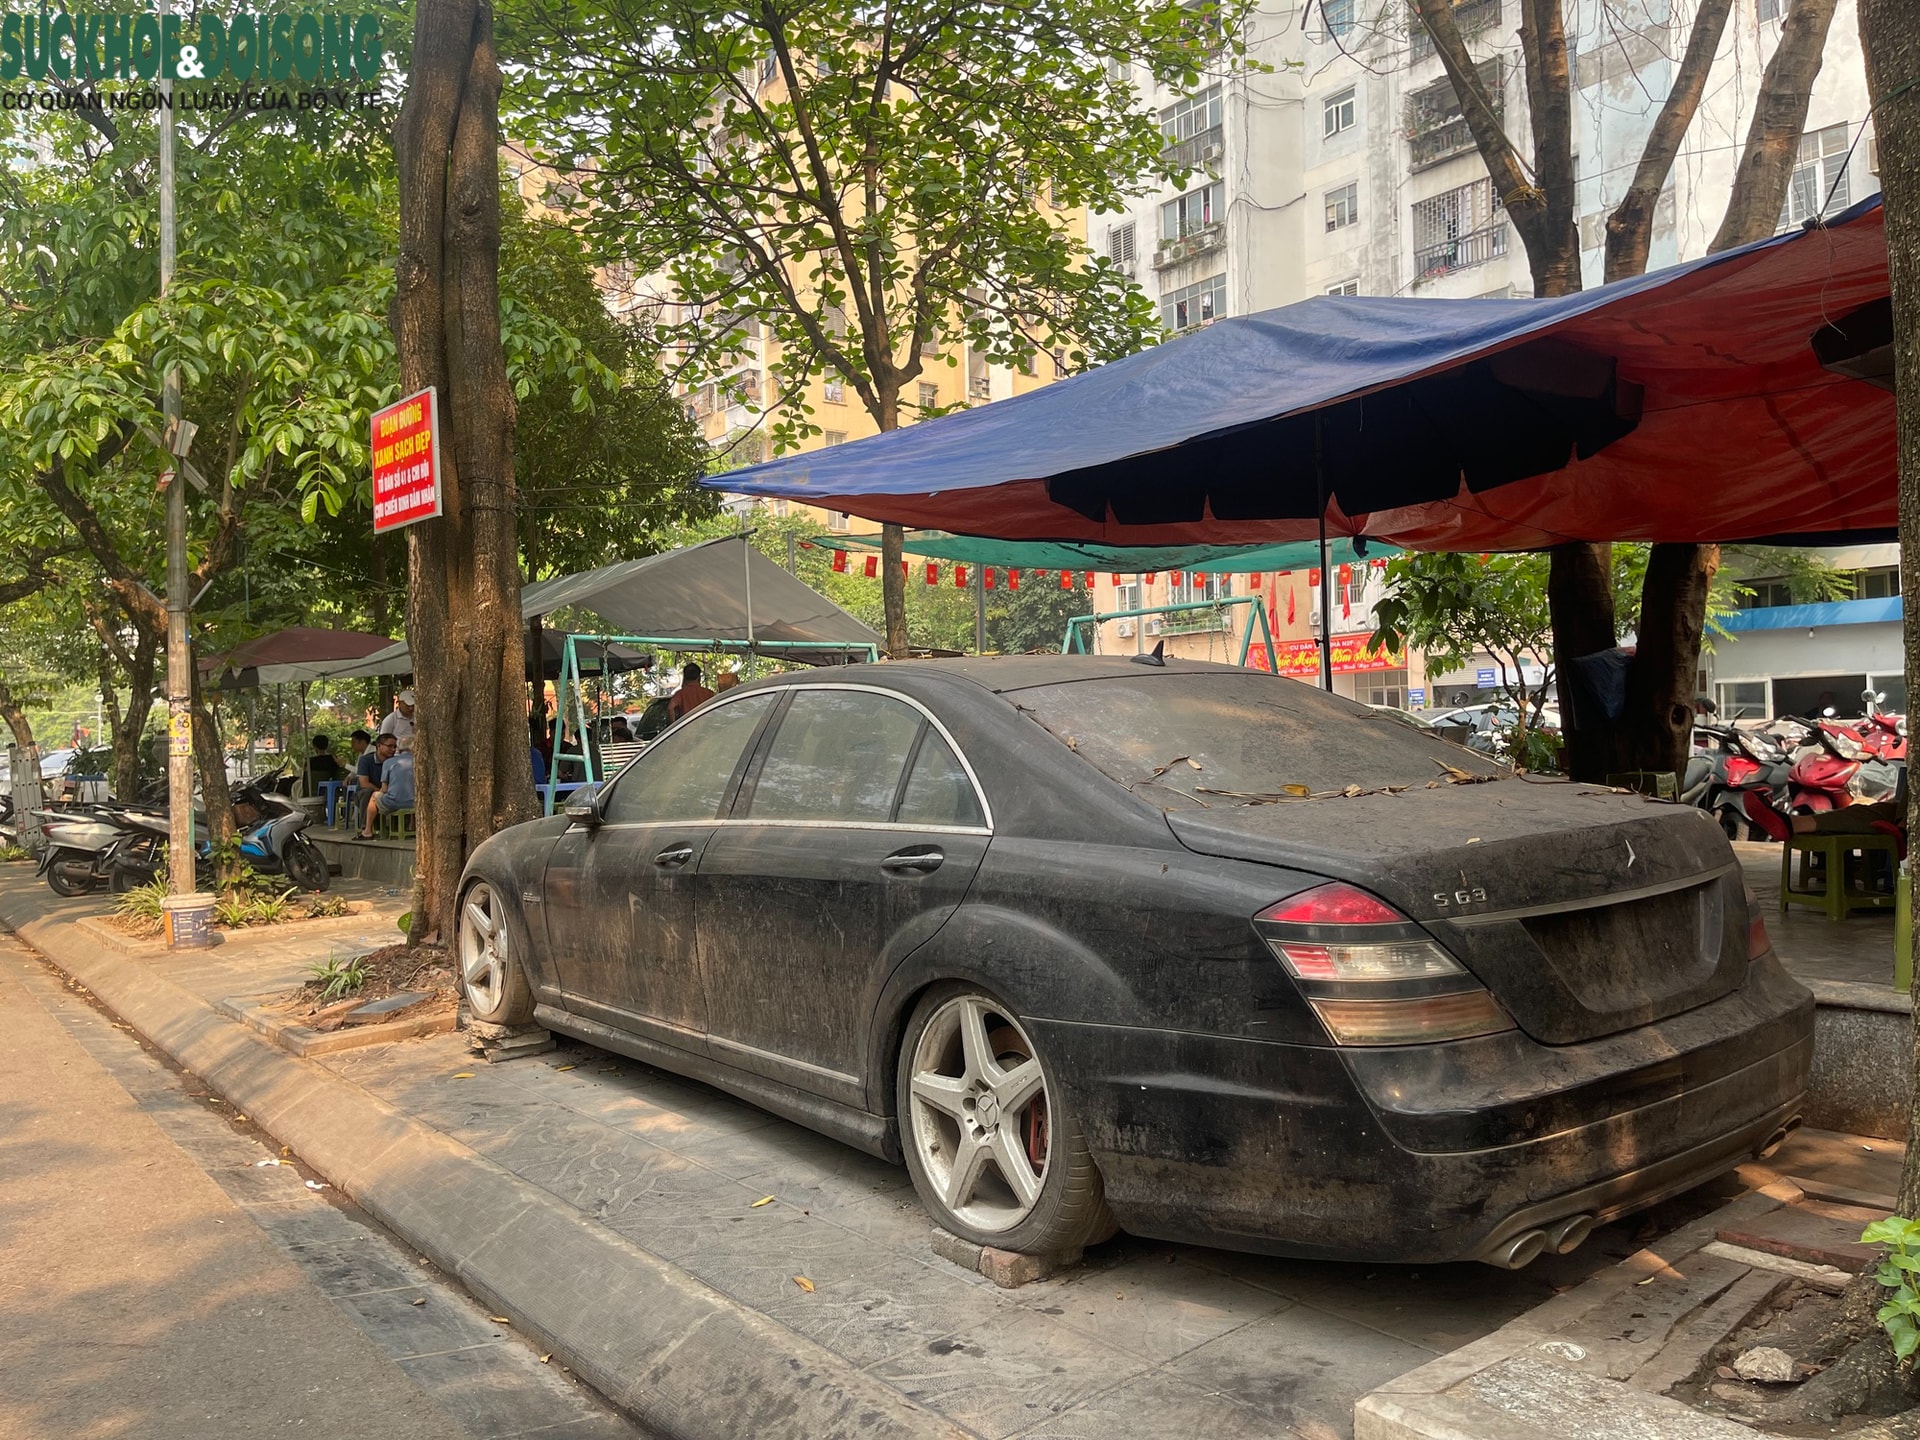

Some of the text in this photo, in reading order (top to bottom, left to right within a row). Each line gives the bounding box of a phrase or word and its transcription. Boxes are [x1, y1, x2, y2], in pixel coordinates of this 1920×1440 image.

[375, 429, 431, 469] XANH SẠCH ĐẸP
